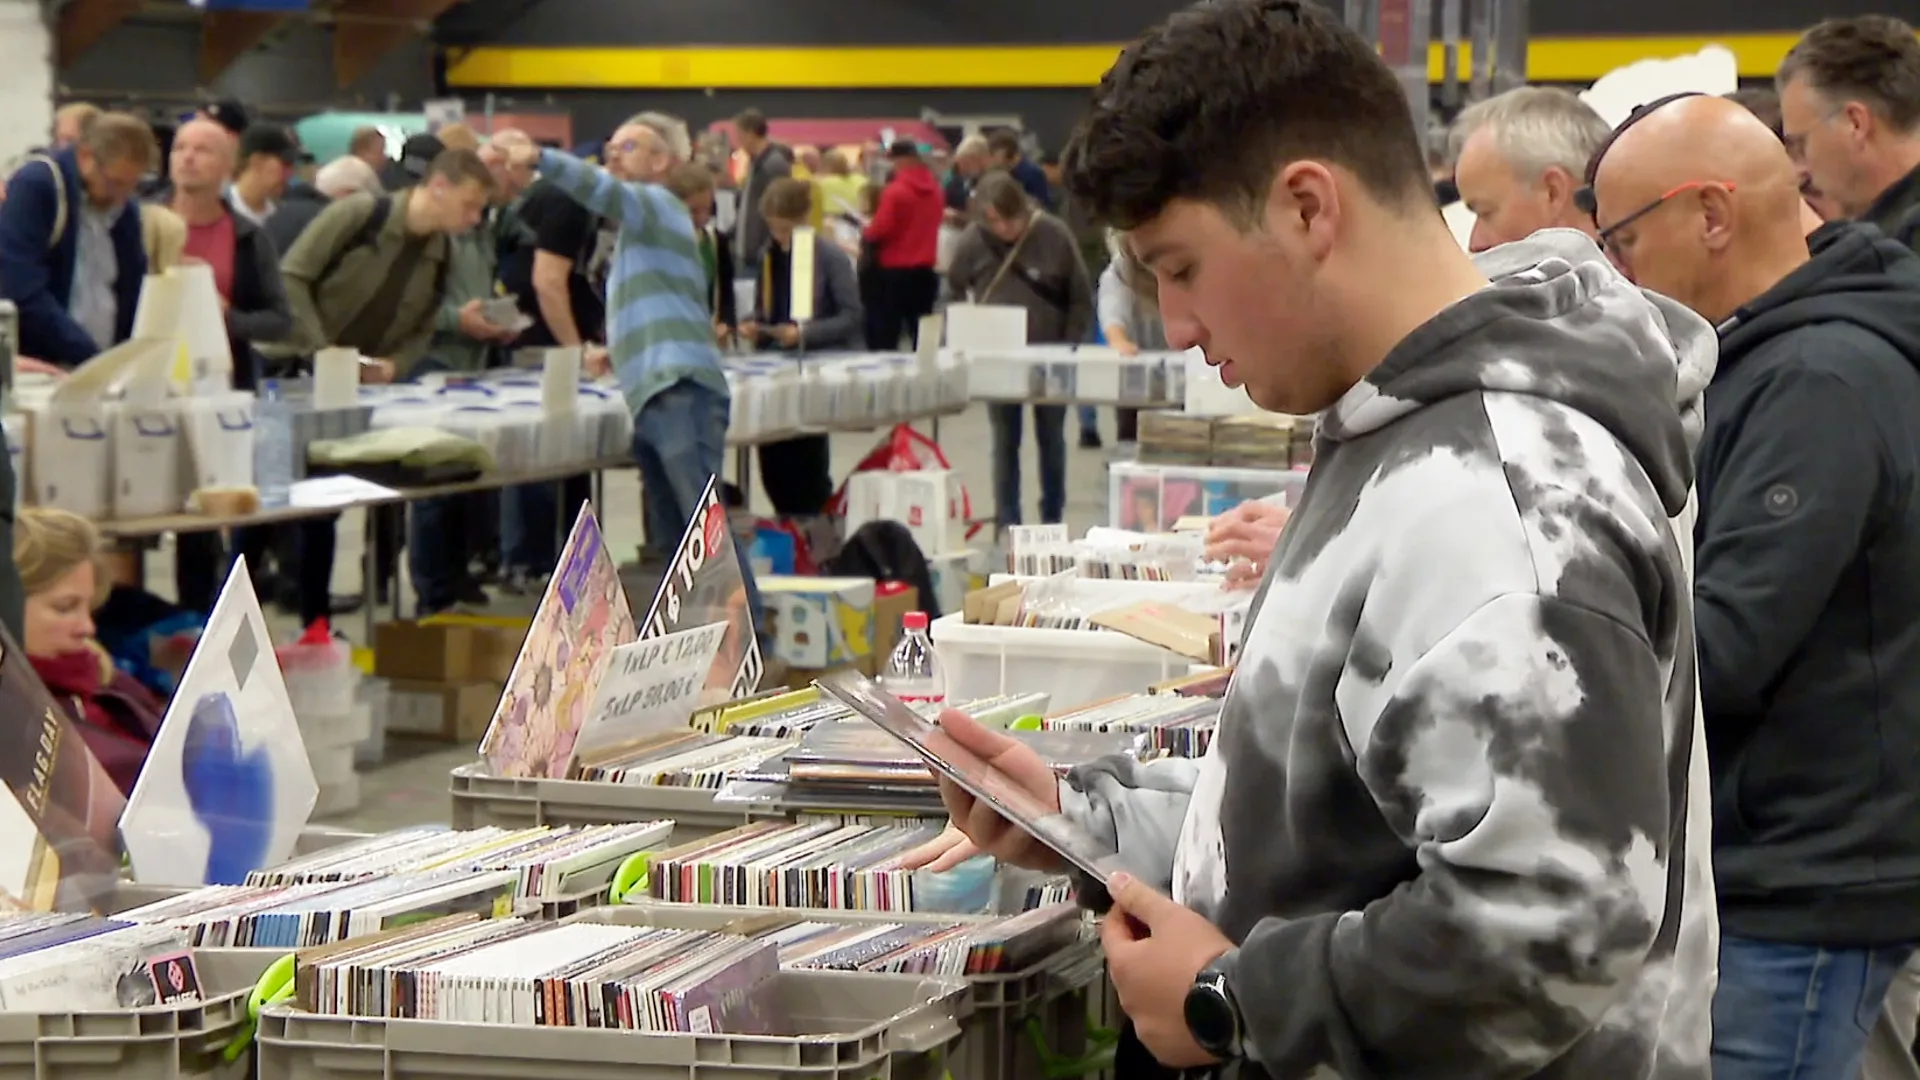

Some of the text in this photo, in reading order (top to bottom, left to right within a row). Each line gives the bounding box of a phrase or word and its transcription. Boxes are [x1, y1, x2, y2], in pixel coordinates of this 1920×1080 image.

[622, 643, 660, 675] 1xLP
[601, 689, 643, 721] 5xLP
[27, 706, 58, 811] FLAG DAY
